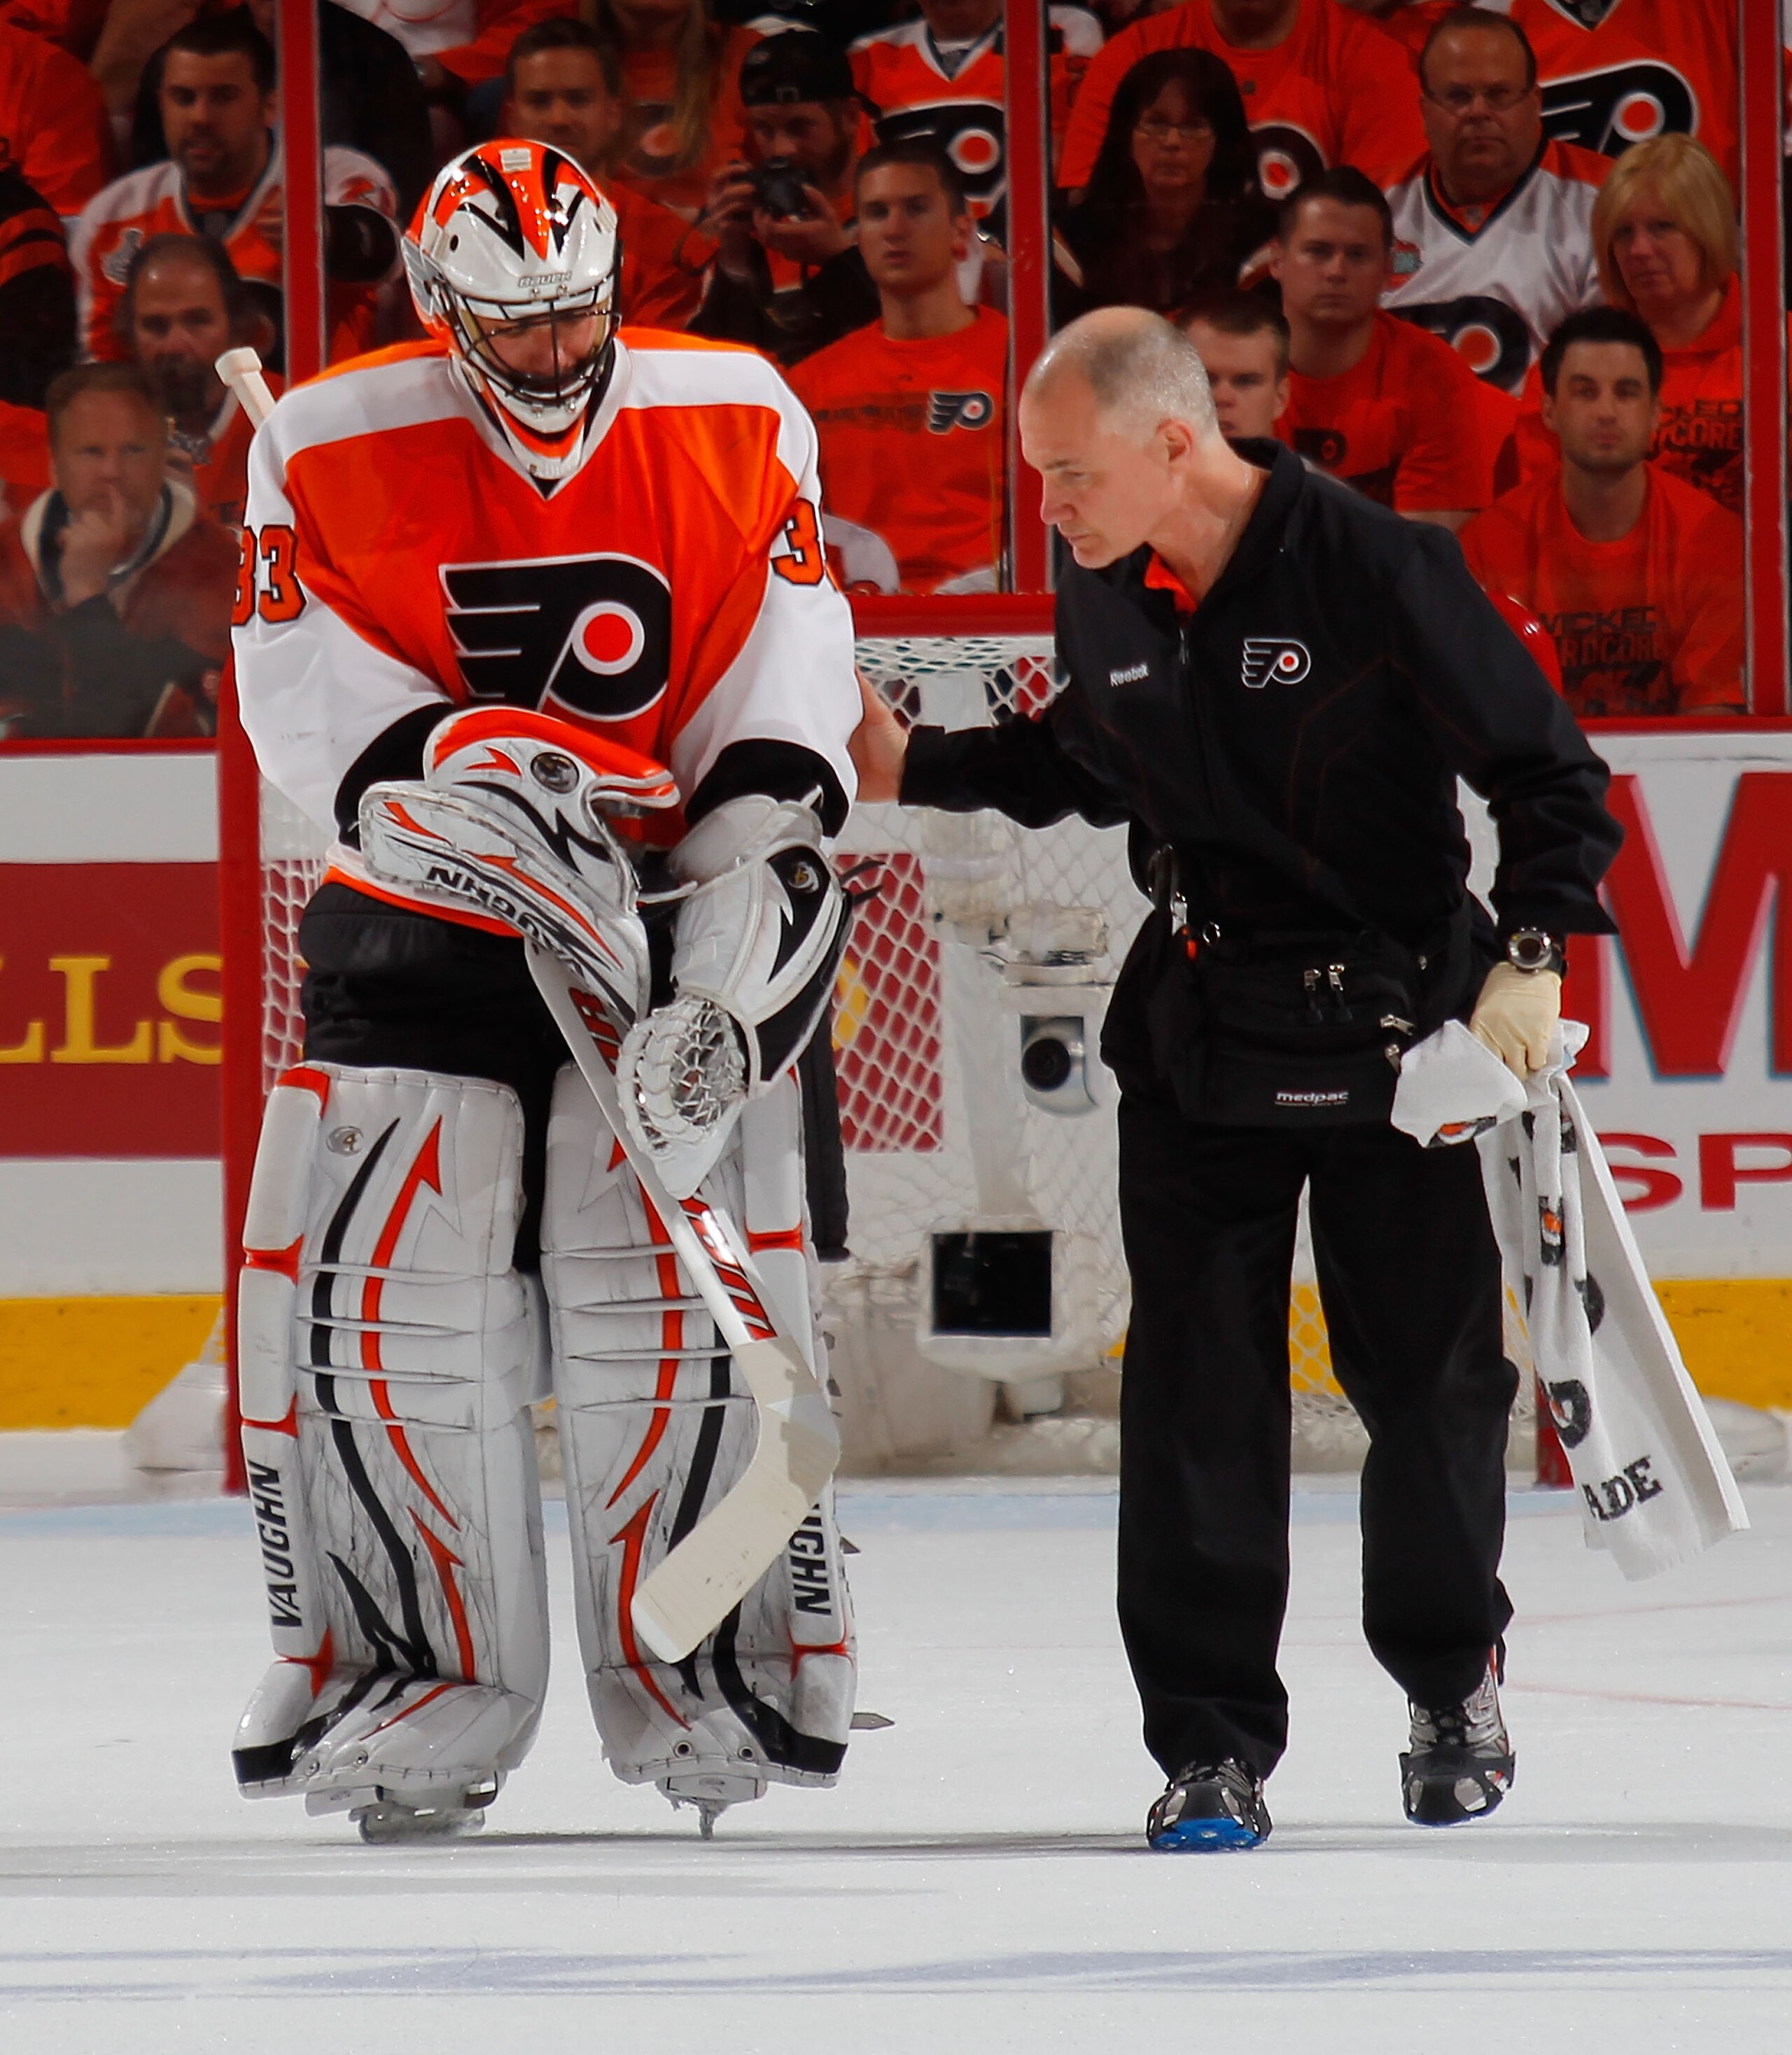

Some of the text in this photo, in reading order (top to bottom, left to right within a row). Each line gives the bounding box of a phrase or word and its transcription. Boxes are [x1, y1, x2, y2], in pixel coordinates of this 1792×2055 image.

[1110, 661, 1149, 687] Reebok
[1276, 1092, 1348, 1104] medpac
[247, 1459, 302, 1627] VAUGHN
